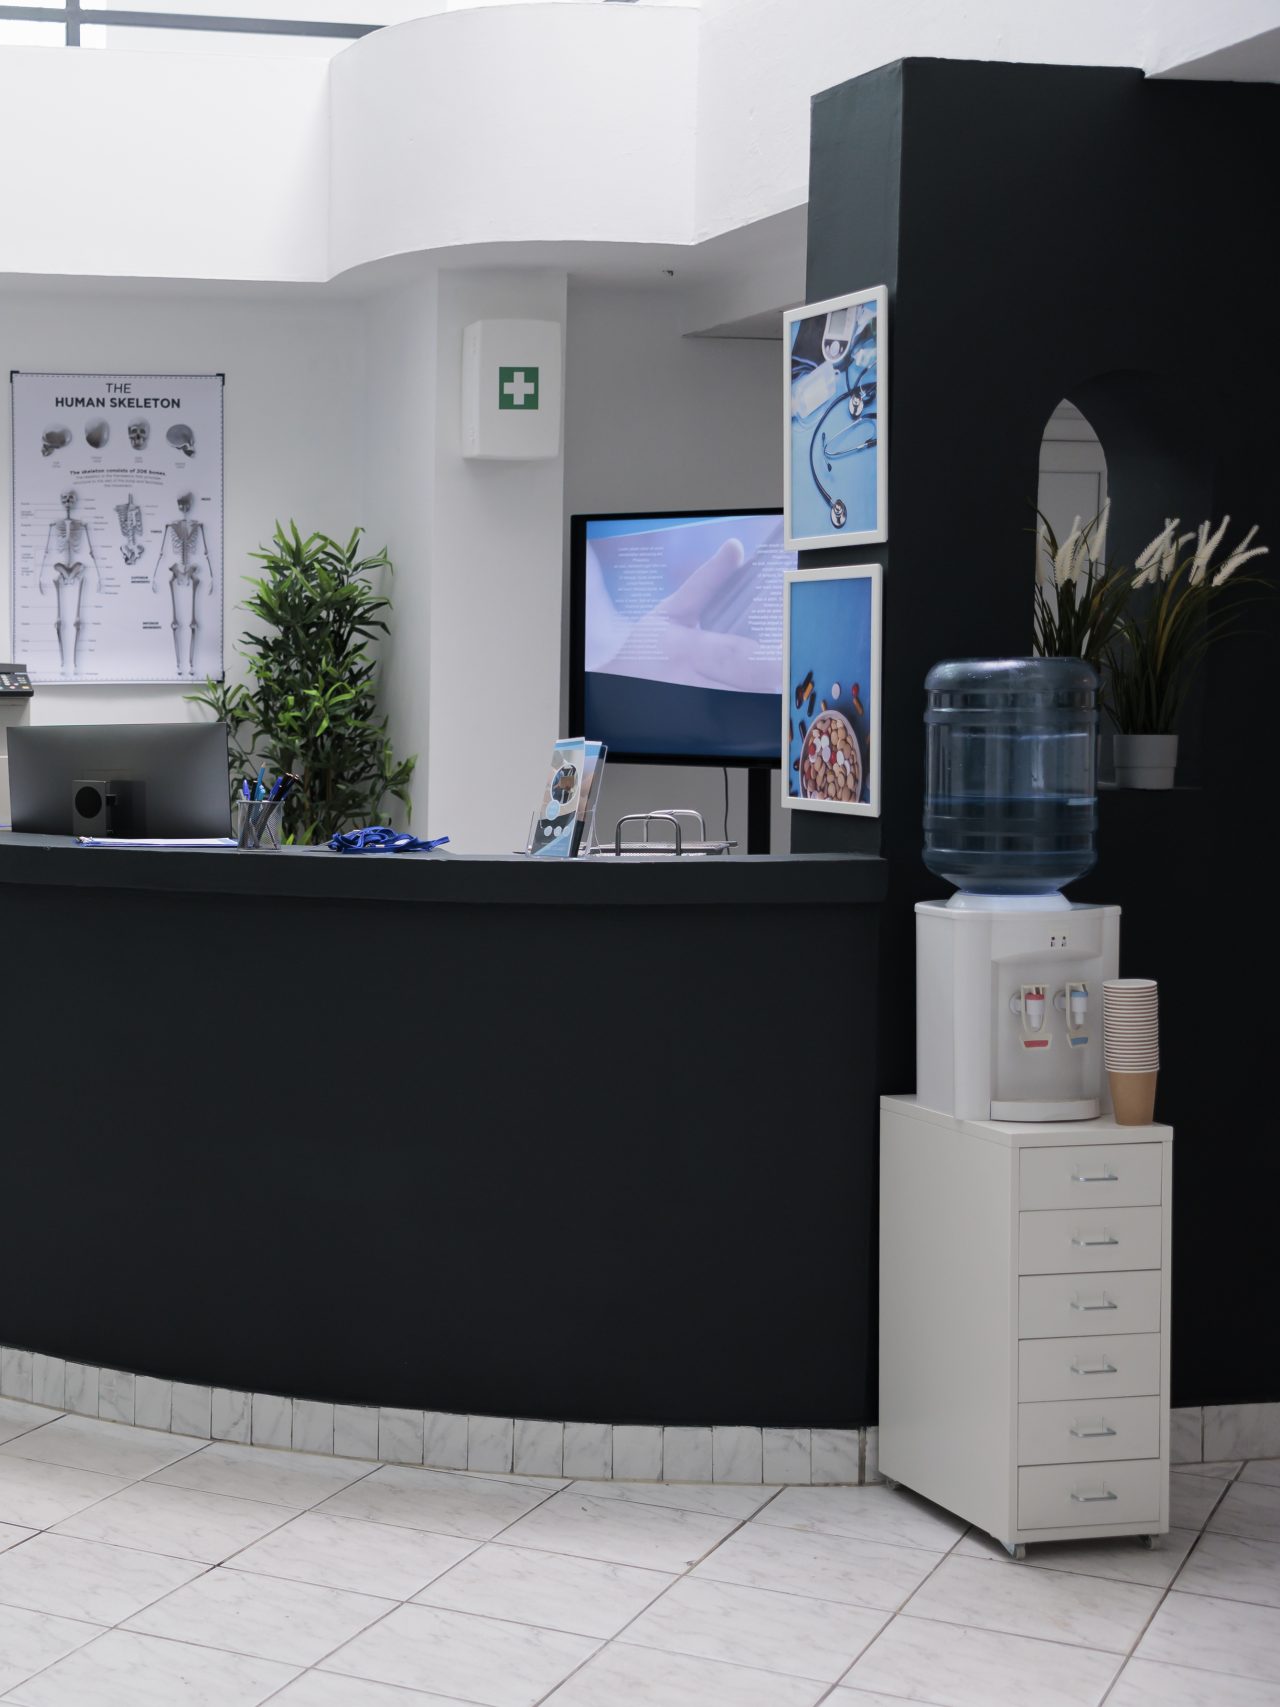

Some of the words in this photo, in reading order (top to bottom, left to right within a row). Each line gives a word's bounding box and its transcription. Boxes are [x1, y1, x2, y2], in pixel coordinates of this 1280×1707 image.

[106, 383, 132, 394] THE
[55, 397, 106, 408] HUMAN
[109, 397, 181, 409] SKELETON
